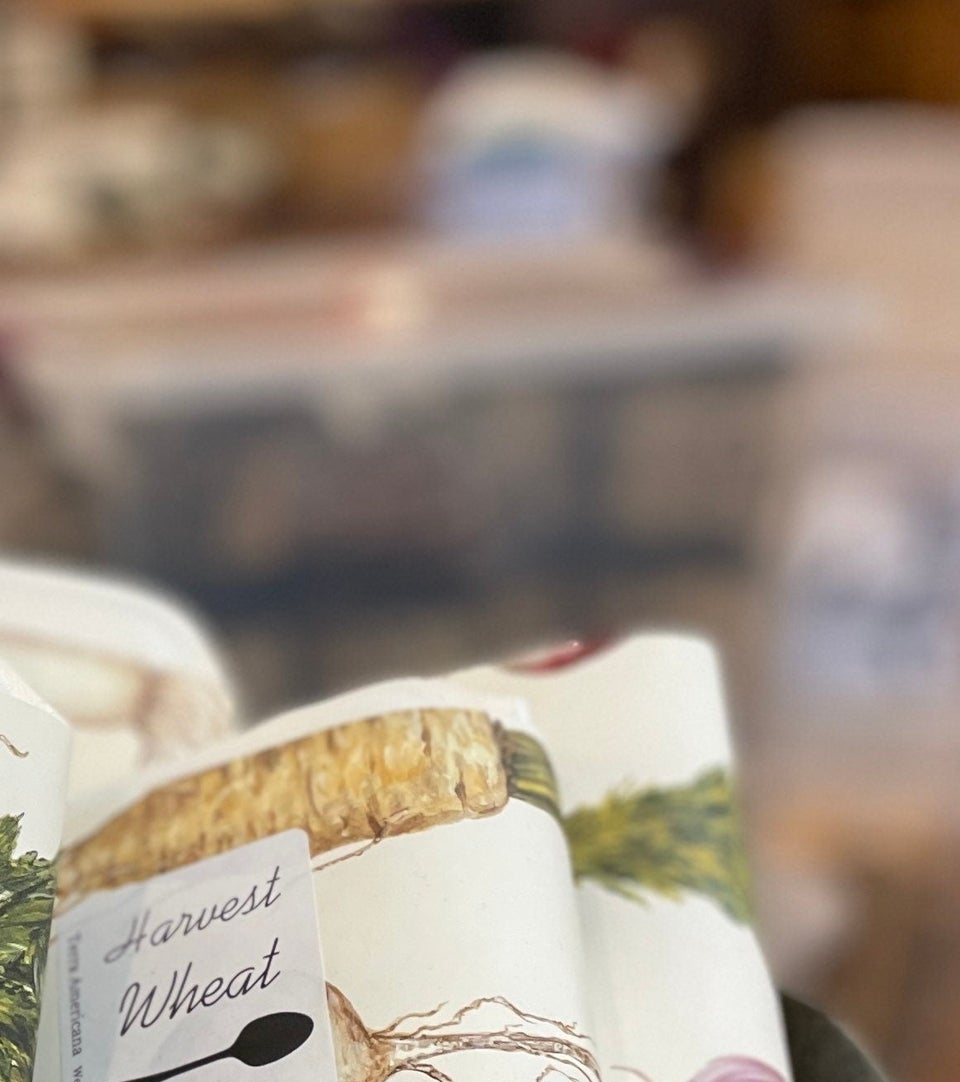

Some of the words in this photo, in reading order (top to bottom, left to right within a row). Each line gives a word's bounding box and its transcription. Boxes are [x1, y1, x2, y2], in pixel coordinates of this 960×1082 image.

[67, 929, 83, 973] Terra
[103, 865, 282, 963] Harvest
[67, 974, 83, 1057] Americana
[118, 936, 281, 1037] Wheat
